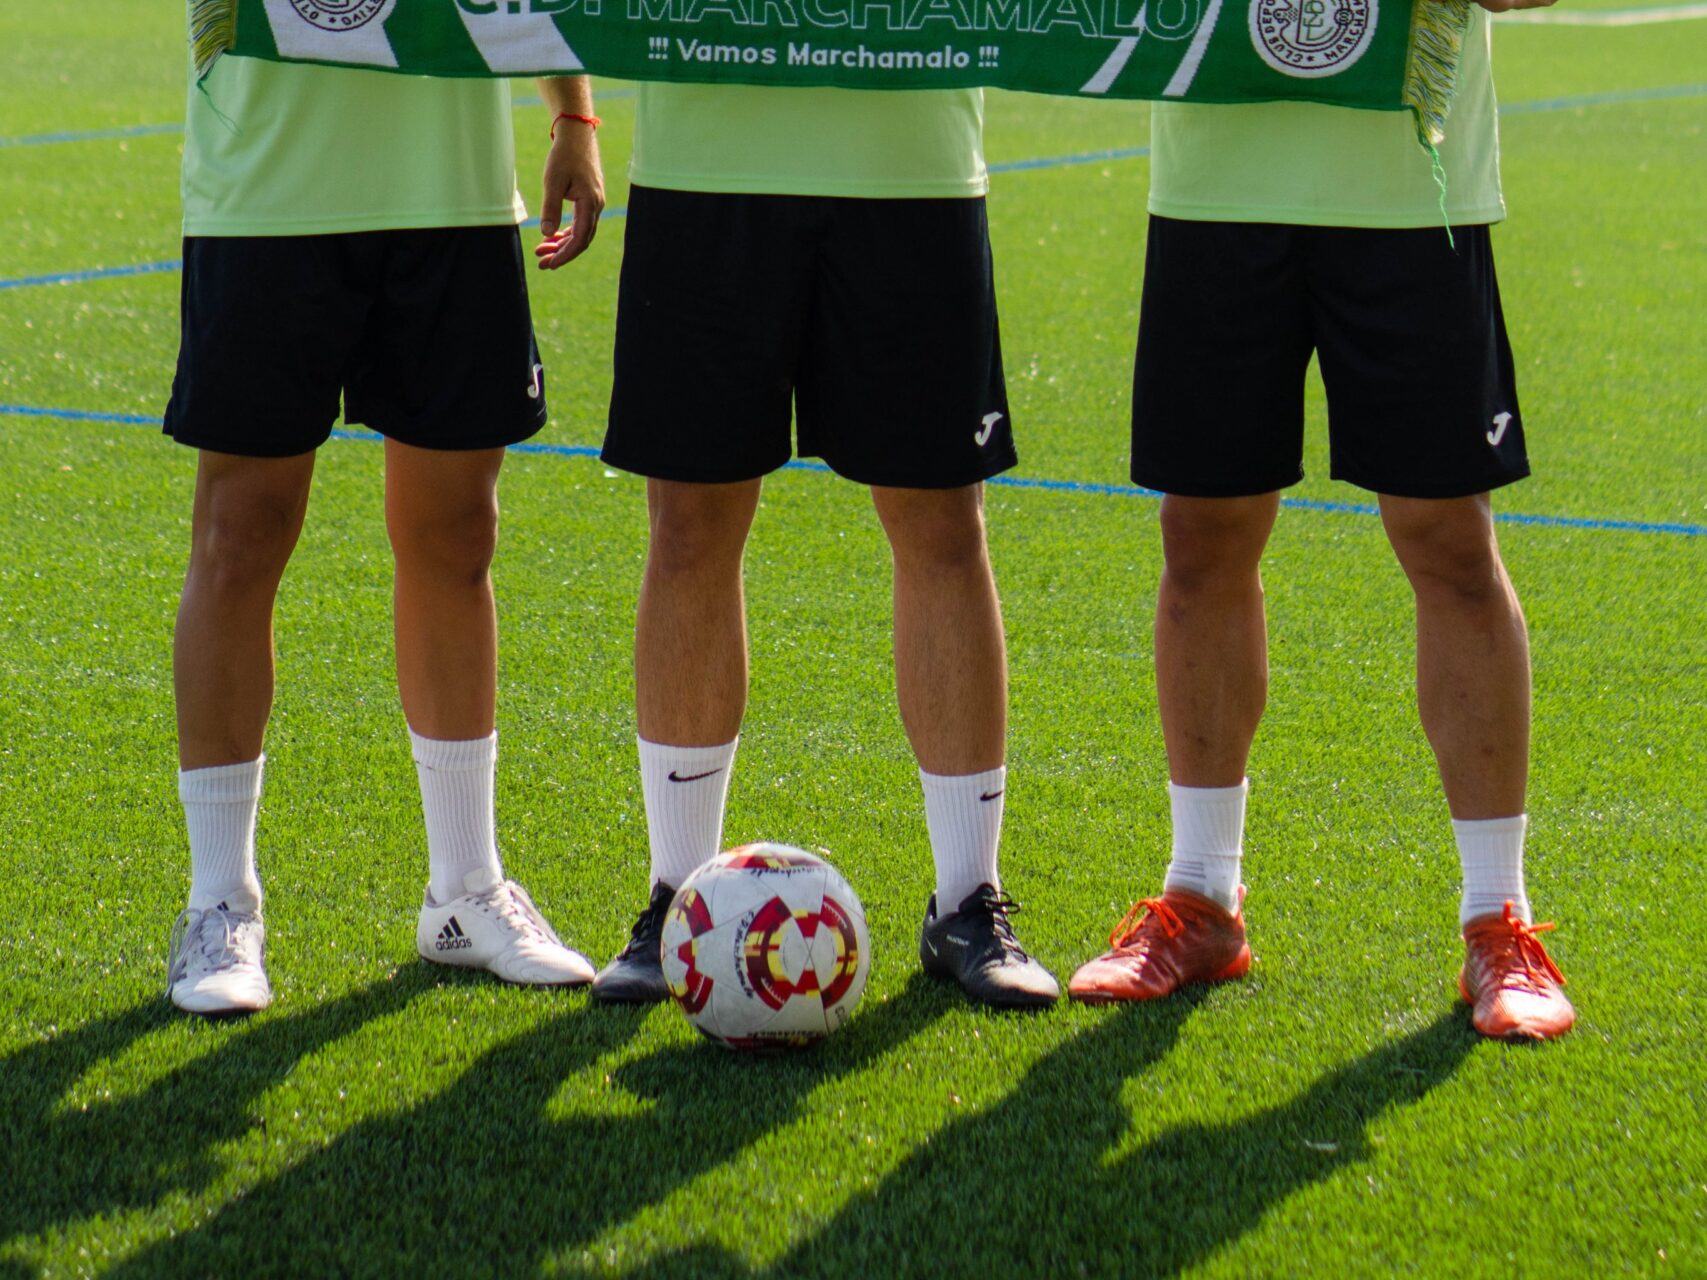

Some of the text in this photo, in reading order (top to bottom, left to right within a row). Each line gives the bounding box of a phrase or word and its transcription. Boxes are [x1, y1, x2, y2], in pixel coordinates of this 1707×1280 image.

[677, 38, 777, 64] Vamos
[788, 41, 970, 70] Marchamalo
[1268, 36, 1305, 63] CLUB
[435, 937, 472, 951] adidas
